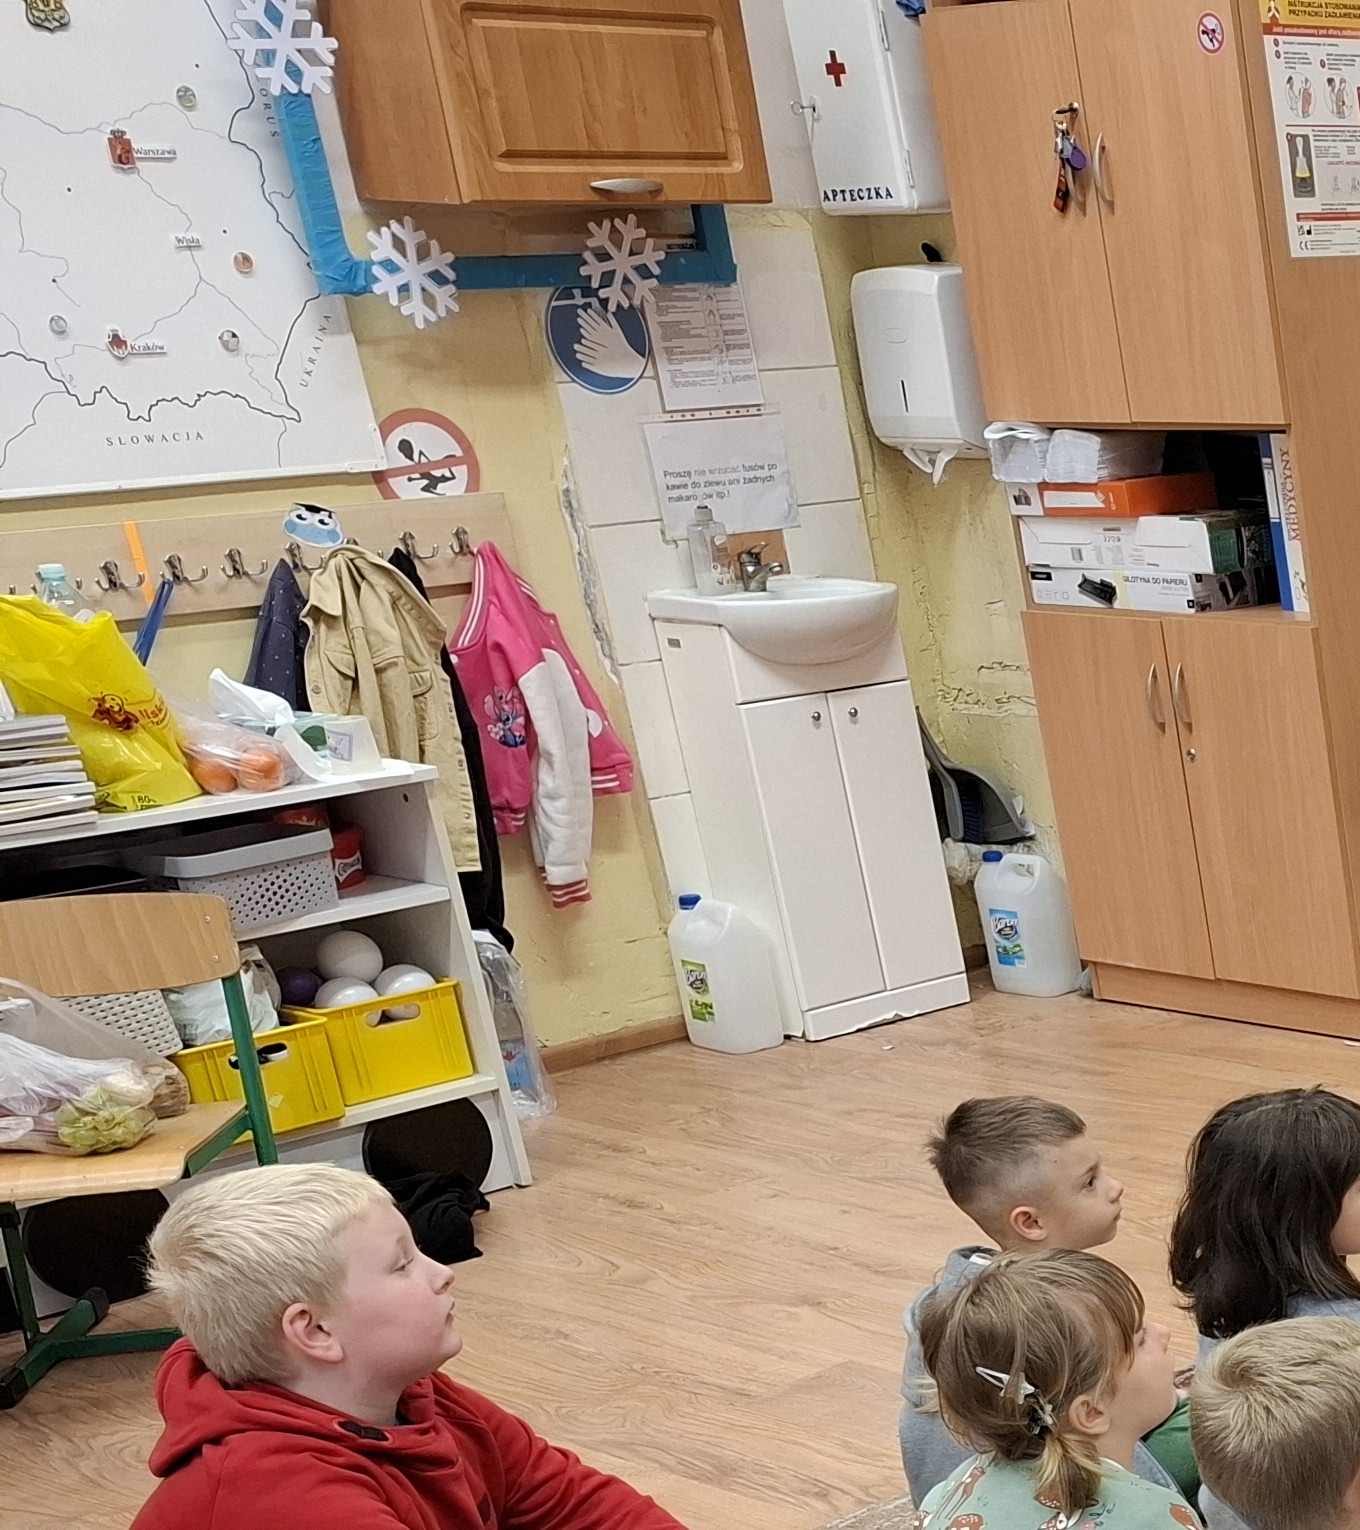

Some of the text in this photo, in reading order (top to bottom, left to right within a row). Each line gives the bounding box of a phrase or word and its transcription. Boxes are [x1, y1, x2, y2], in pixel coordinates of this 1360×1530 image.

[133, 147, 177, 157] Warszawa
[822, 186, 894, 203] APTECZKA
[129, 341, 165, 351] Kraków
[299, 315, 332, 388] UKRAINA
[663, 470, 692, 479] Proszę
[693, 468, 706, 477] nie
[767, 463, 778, 472] po
[690, 481, 701, 489] do
